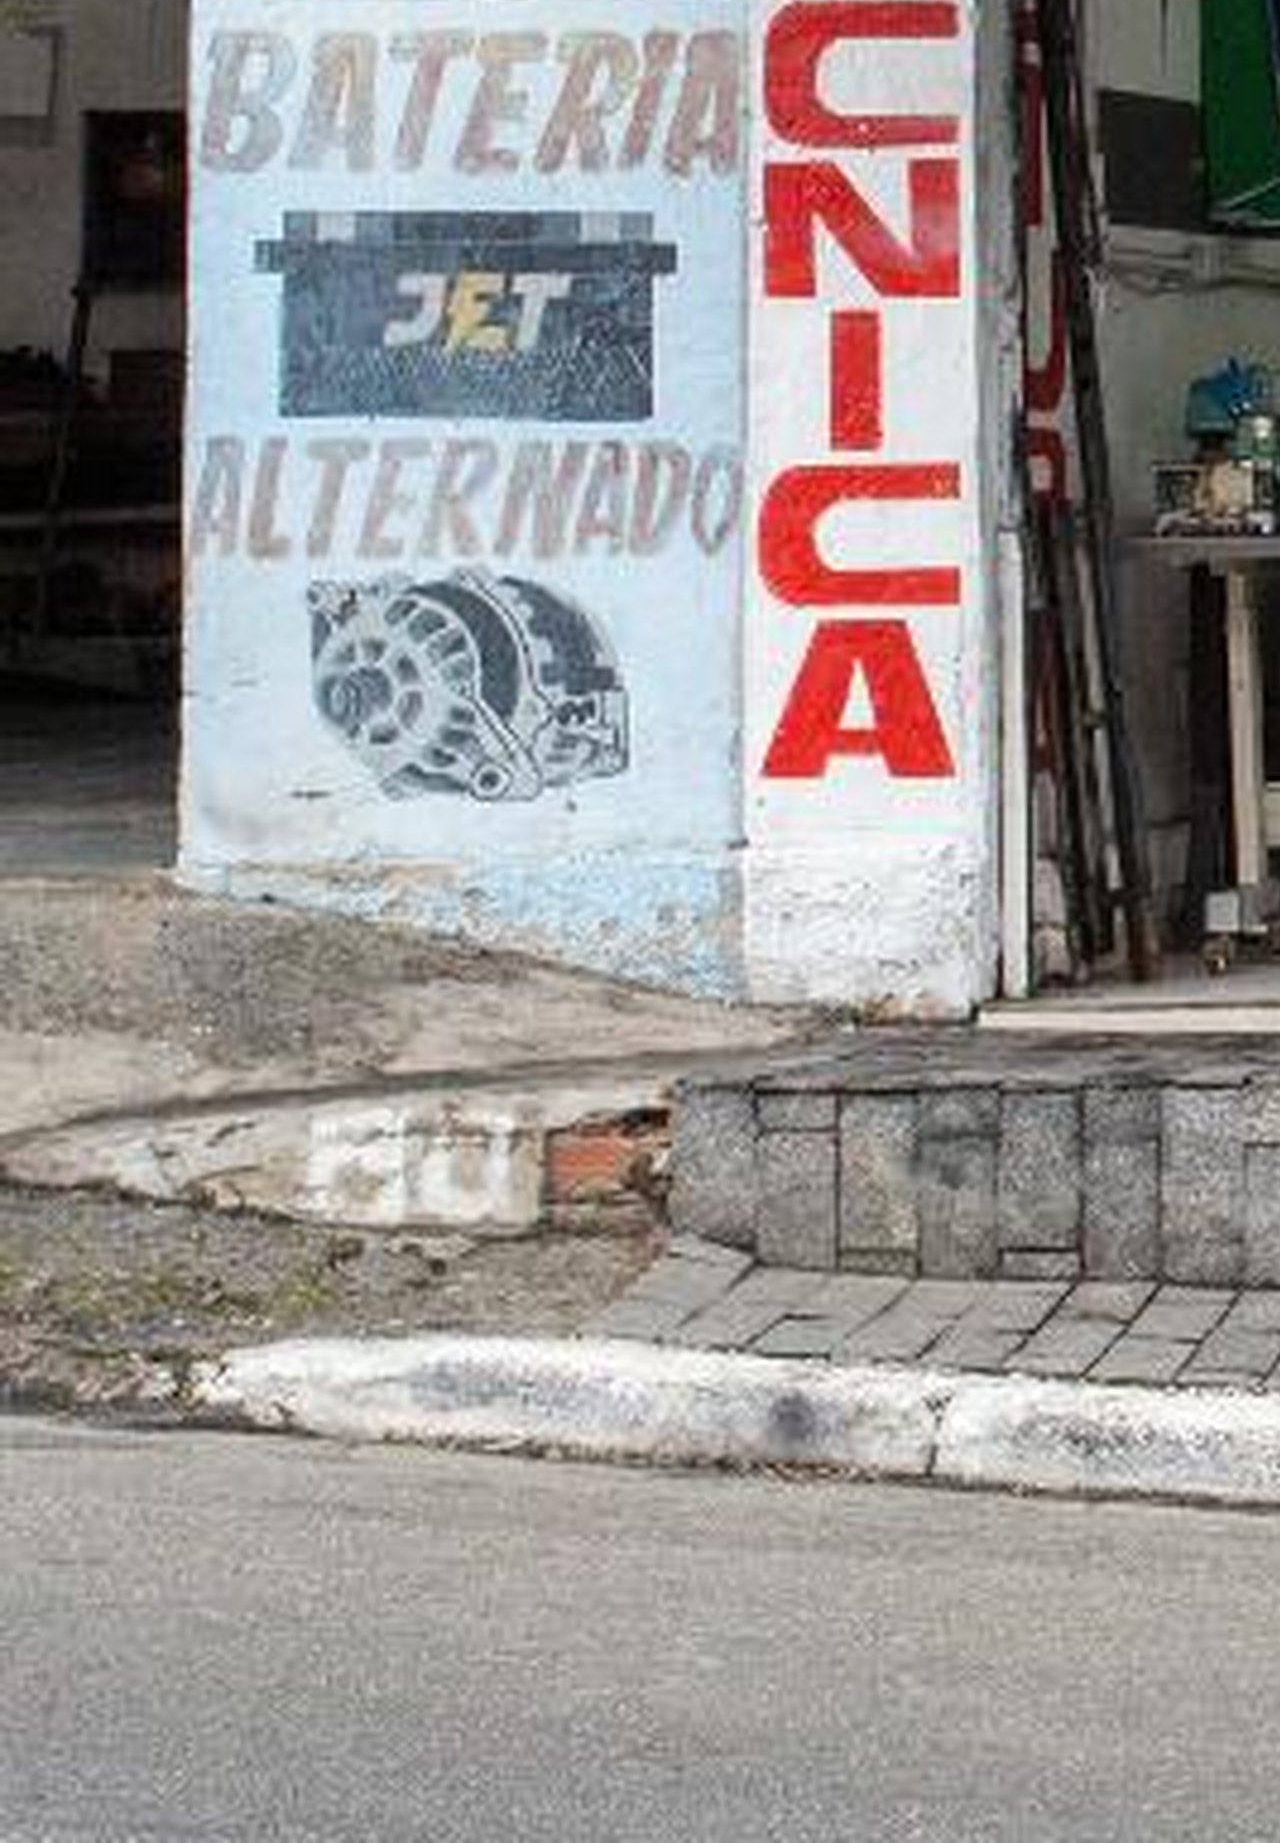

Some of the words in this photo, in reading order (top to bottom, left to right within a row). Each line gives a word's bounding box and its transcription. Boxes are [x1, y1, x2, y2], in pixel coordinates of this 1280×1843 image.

[200, 29, 742, 177] BATERIA
[383, 265, 570, 358] JET
[195, 436, 747, 562] ALTERNADO
